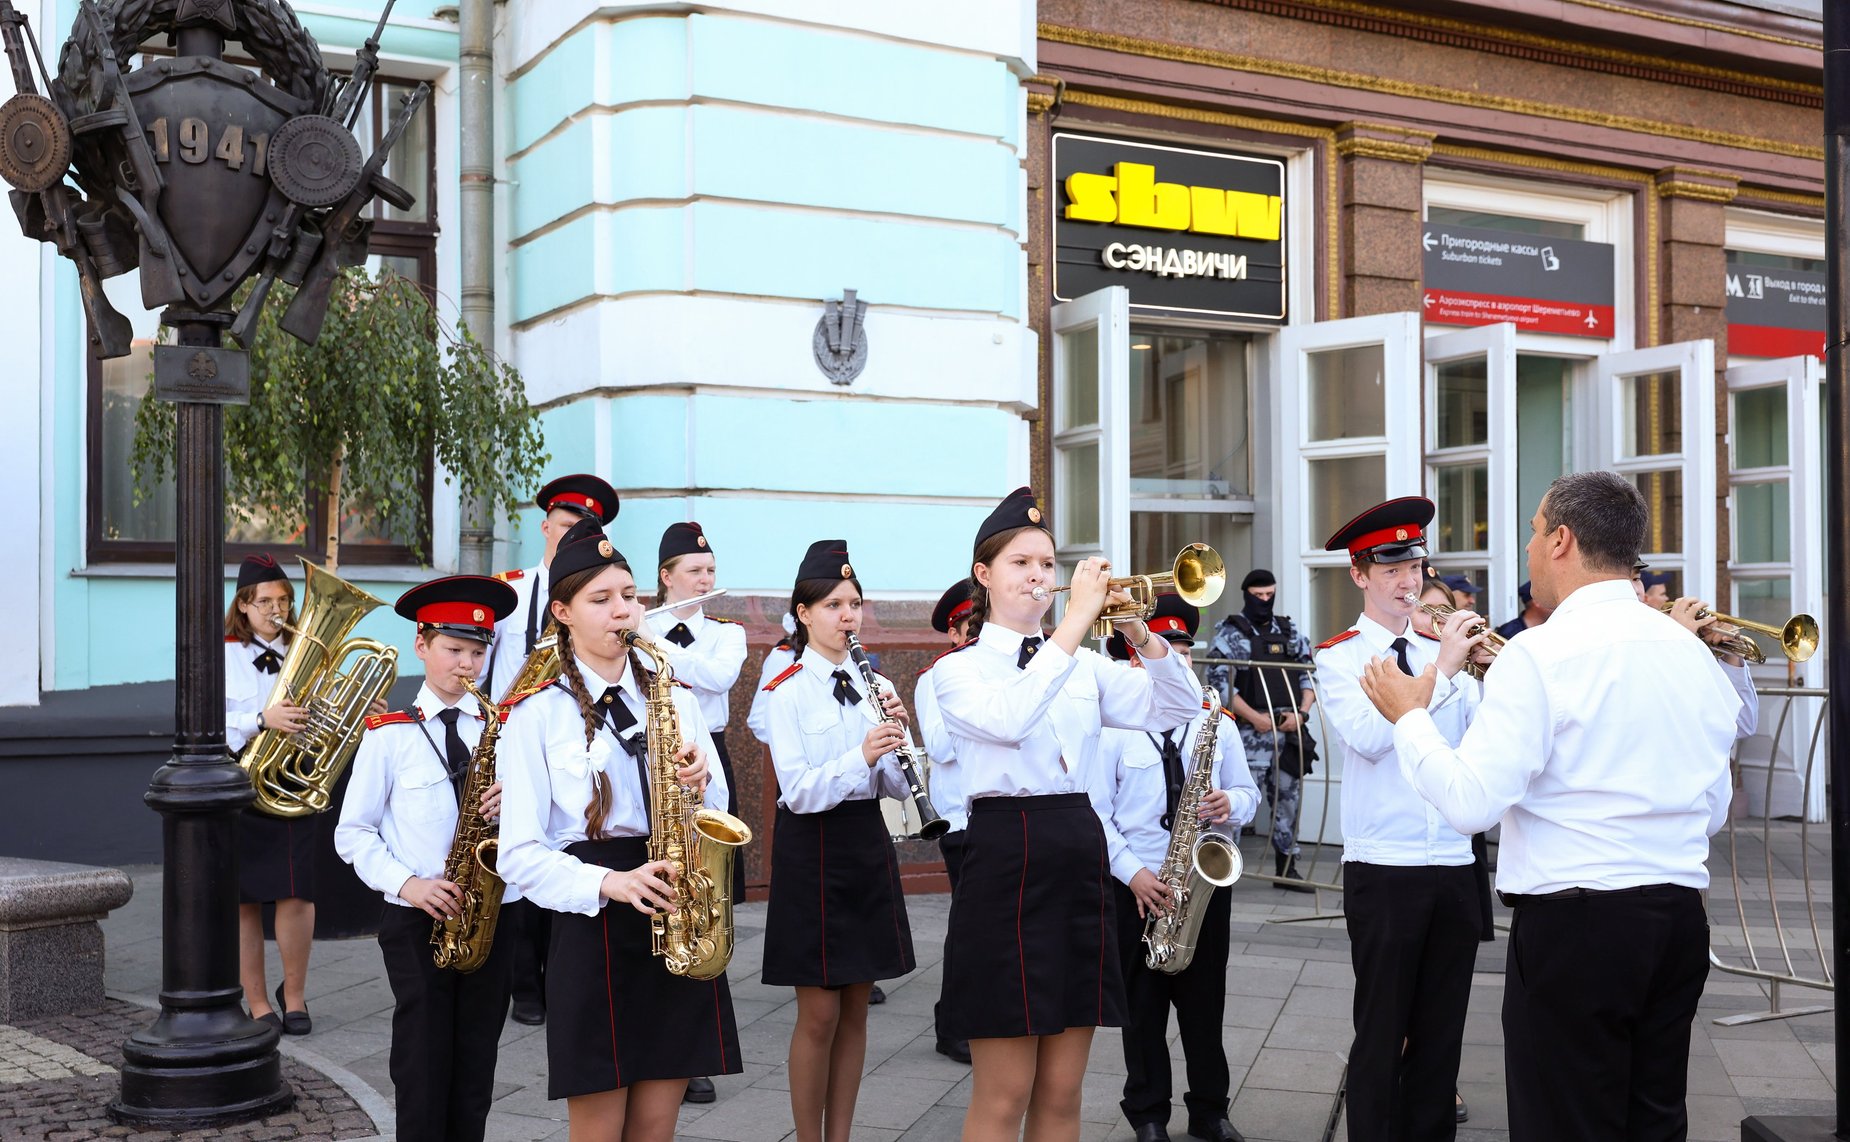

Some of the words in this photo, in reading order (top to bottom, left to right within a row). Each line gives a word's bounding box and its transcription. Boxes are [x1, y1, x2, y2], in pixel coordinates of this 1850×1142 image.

[145, 116, 269, 177] 1941
[1441, 234, 1510, 253] Пригородные
[1511, 244, 1539, 256] кассы
[1102, 242, 1247, 280] СЭНДВИЧИ
[1441, 250, 1478, 263] Suburban
[1478, 255, 1502, 266] tickets
[1764, 276, 1791, 291] Выход
[1797, 281, 1821, 294] город
